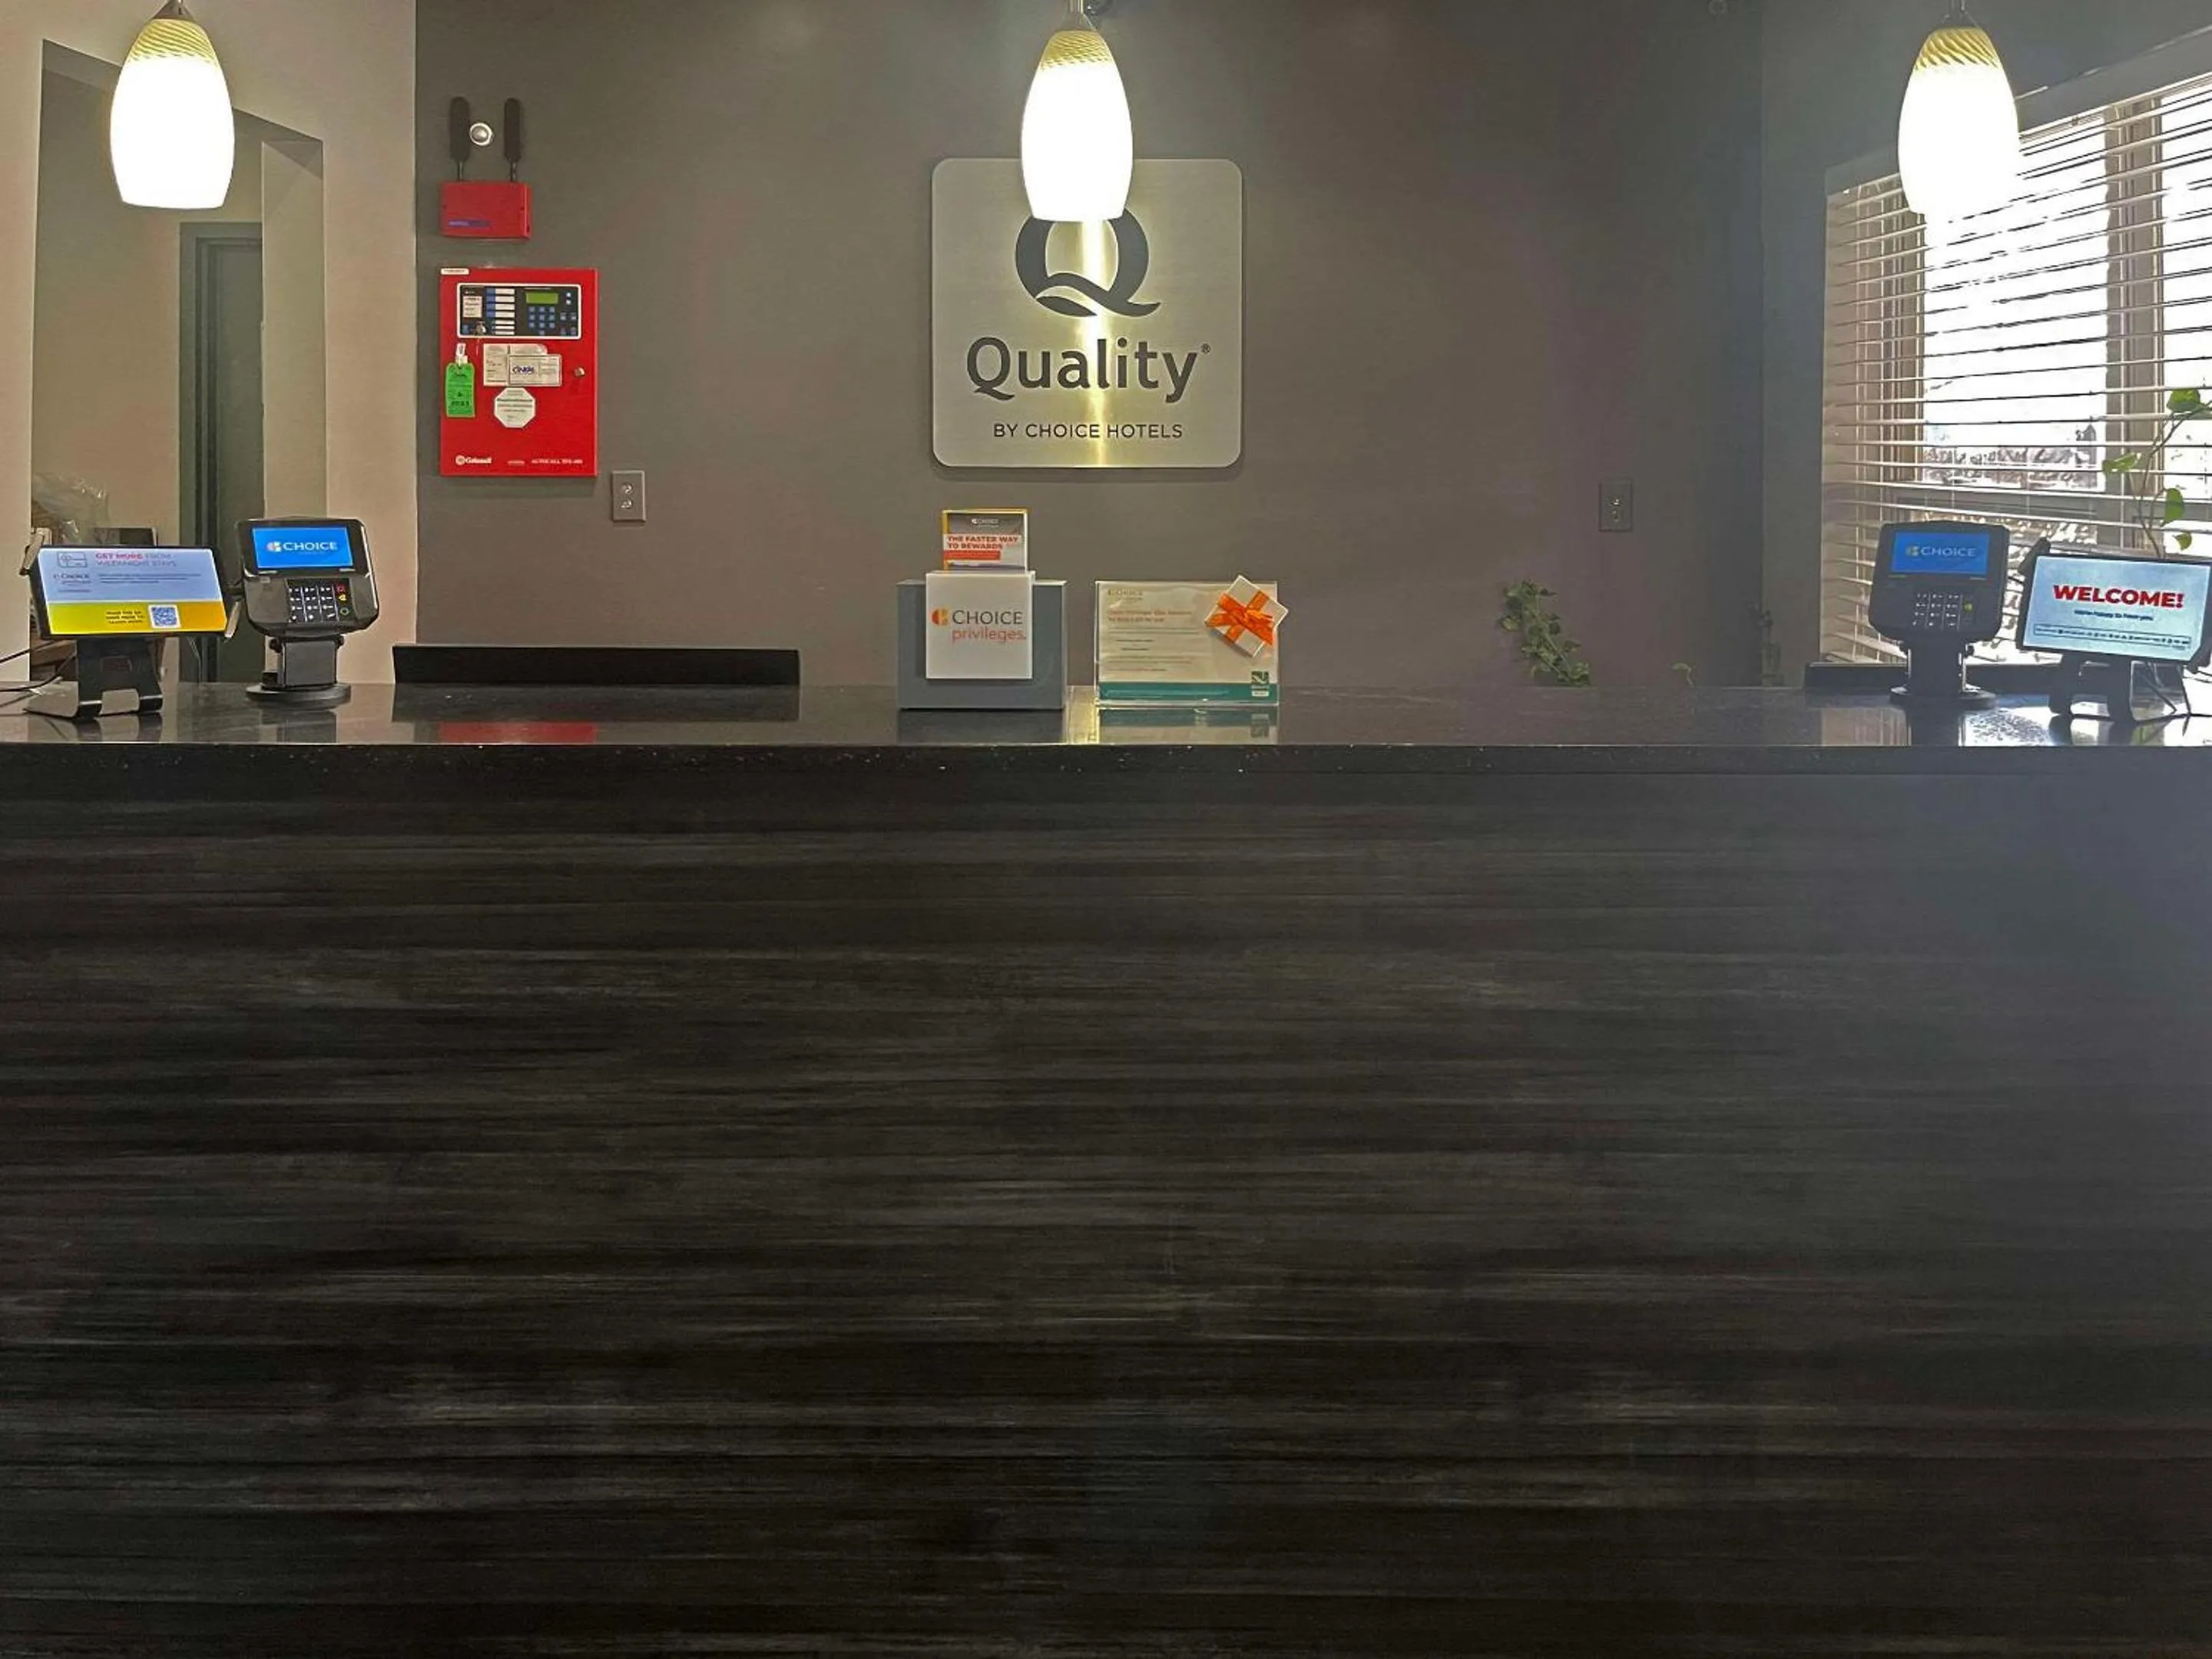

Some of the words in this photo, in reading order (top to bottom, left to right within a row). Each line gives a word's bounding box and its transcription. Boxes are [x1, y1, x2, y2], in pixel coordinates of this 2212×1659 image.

[993, 423, 1018, 439] BY
[1025, 423, 1099, 439] CHOICE
[1107, 423, 1183, 439] HOTELS
[282, 541, 339, 551] CHOICE
[1921, 546, 1977, 558] CHOICE
[2053, 584, 2184, 608] WELCOME!
[952, 609, 1023, 625] CHOICE
